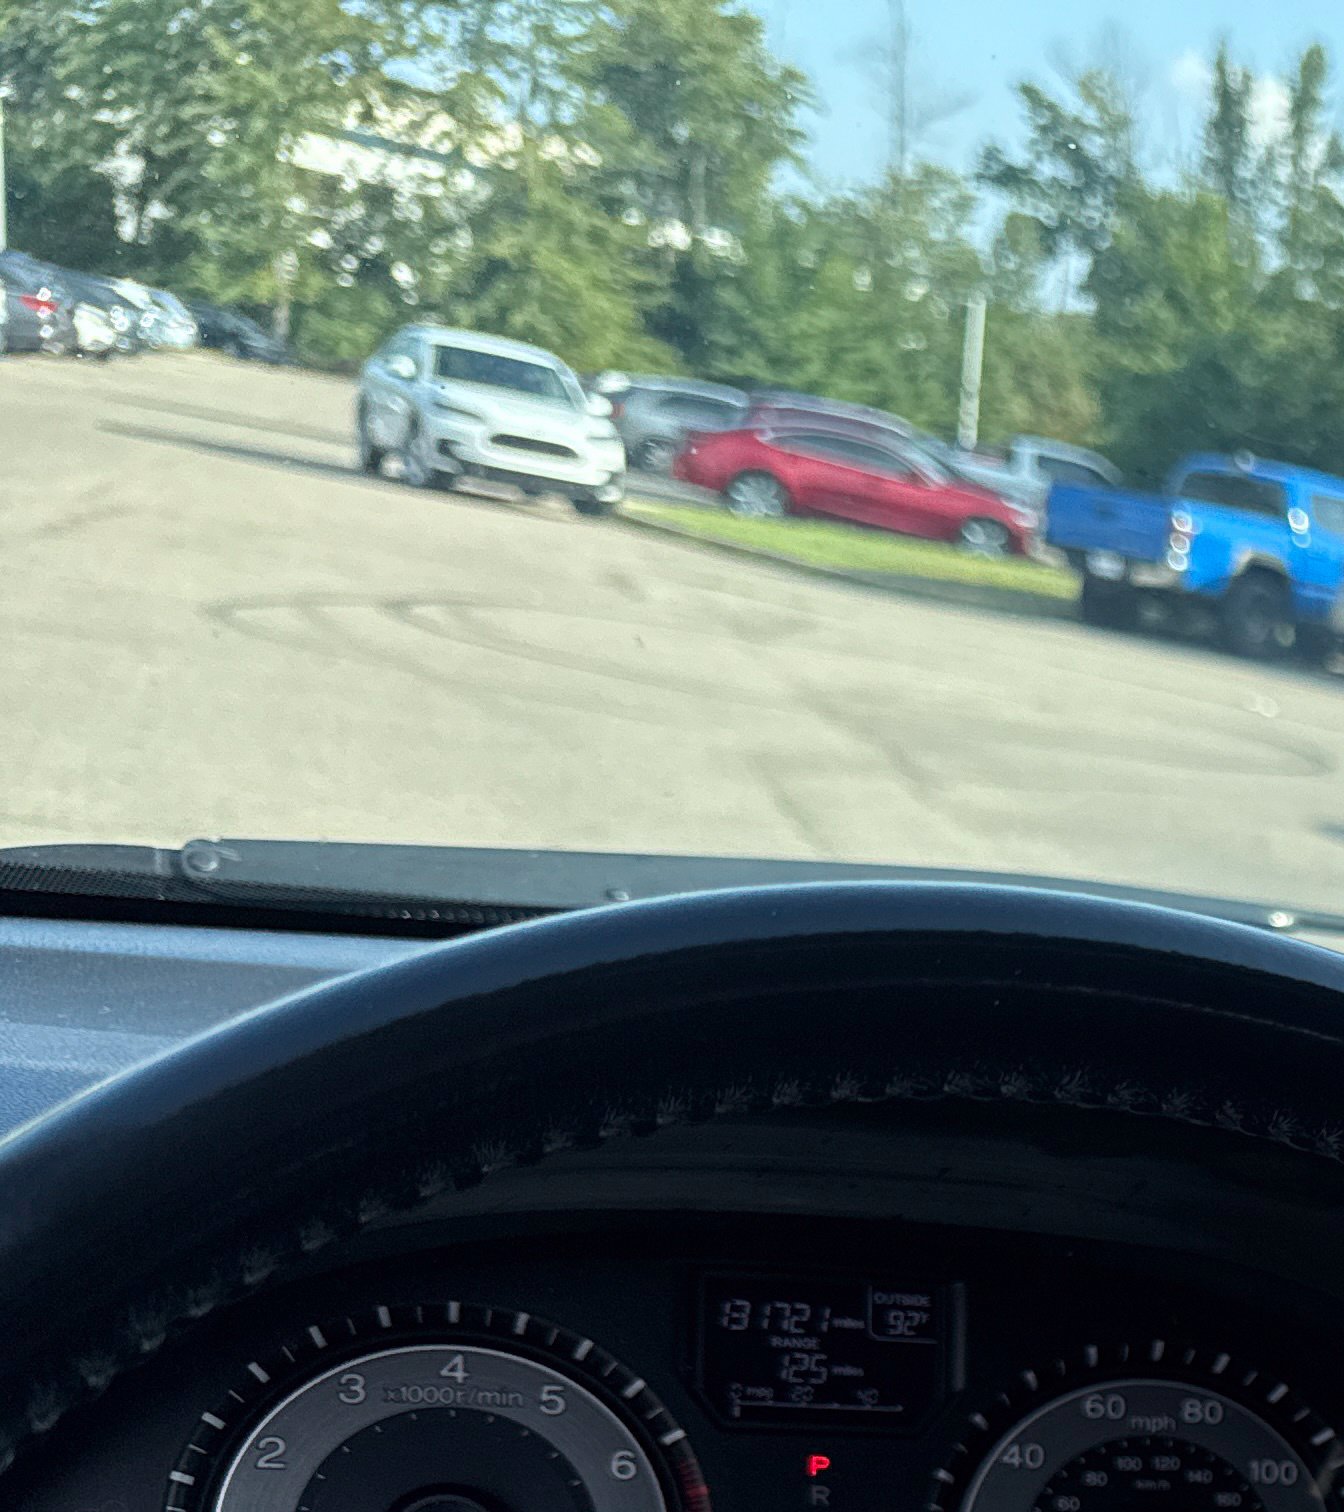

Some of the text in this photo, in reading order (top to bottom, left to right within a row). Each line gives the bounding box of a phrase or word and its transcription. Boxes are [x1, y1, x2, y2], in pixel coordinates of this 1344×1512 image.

[768, 1336, 821, 1351] RANGE
[440, 1354, 471, 1384] 4
[339, 1373, 367, 1405] 3
[540, 1385, 568, 1417] 5
[1084, 1394, 1126, 1421] 60
[1181, 1399, 1224, 1426] 80
[1130, 1414, 1178, 1433] mph
[256, 1436, 288, 1470] 2
[610, 1448, 638, 1481] 6
[807, 1454, 831, 1477] P
[1001, 1443, 1046, 1469] 40
[1249, 1459, 1298, 1485] 100
[811, 1484, 831, 1506] R
